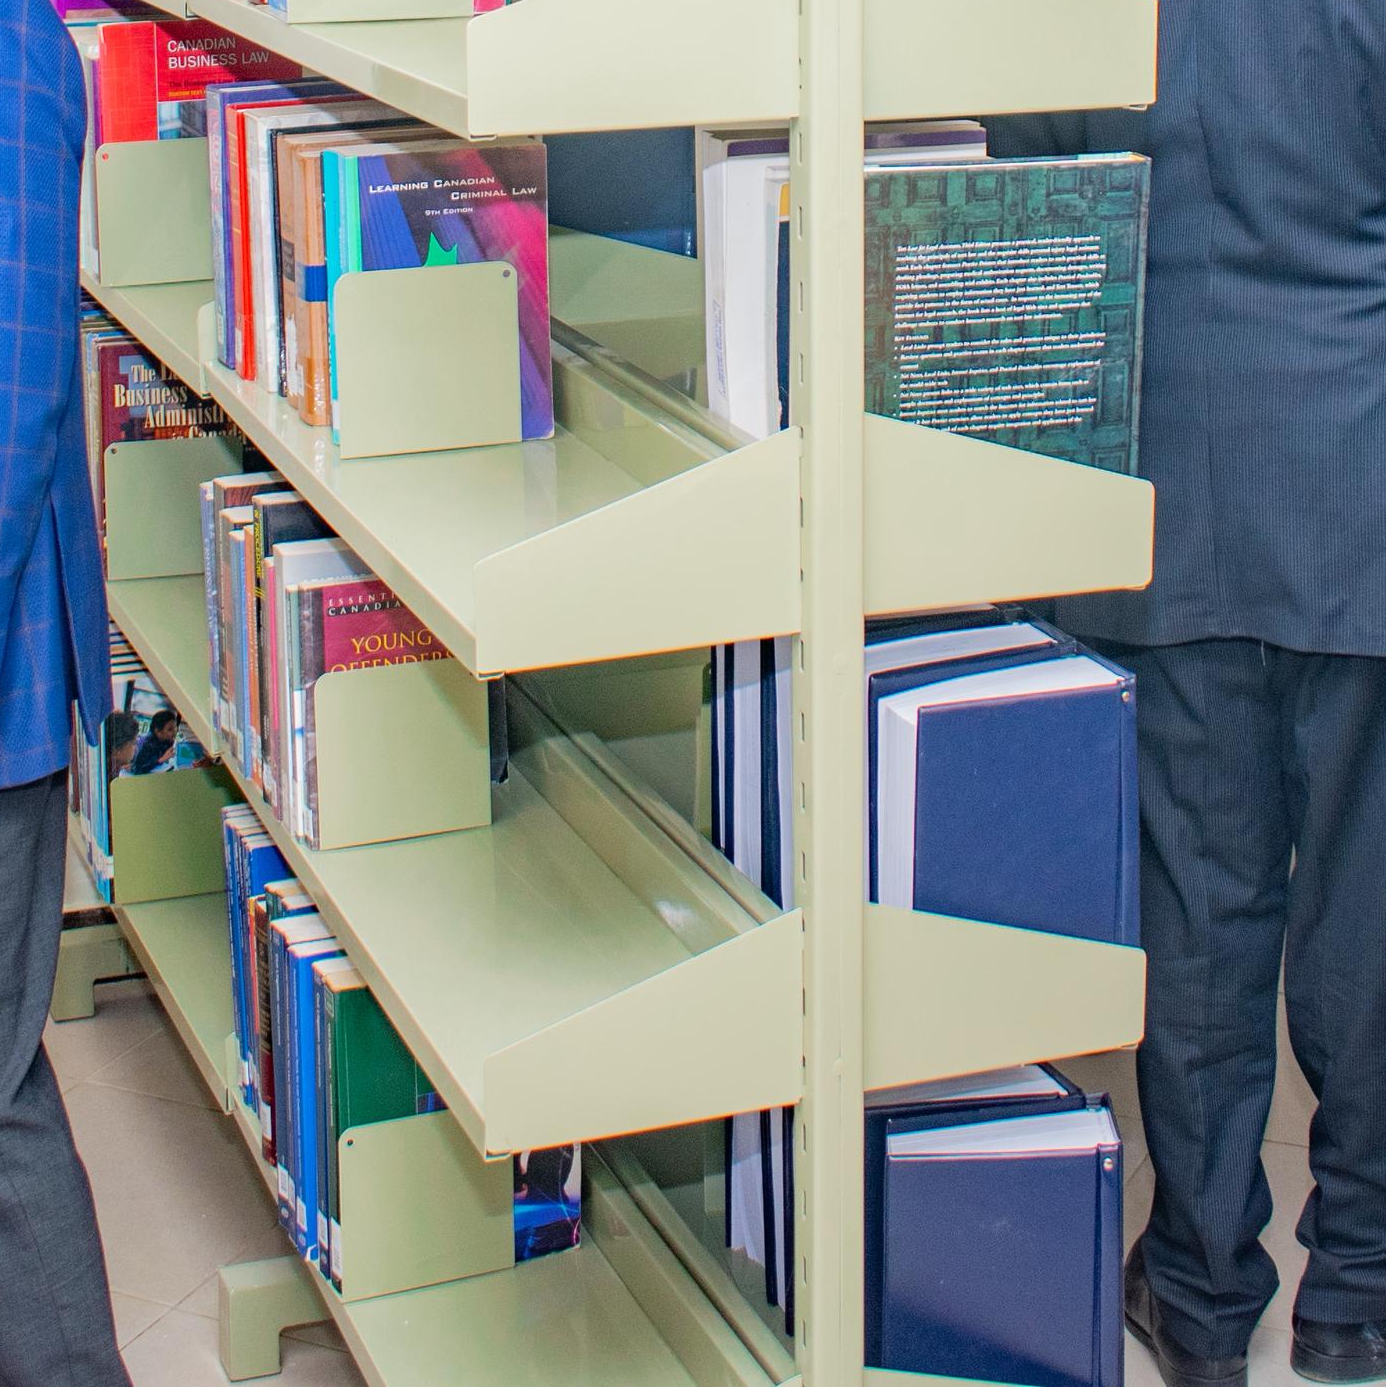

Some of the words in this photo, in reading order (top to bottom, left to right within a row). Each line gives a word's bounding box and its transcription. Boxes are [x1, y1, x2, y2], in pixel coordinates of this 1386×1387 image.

[167, 37, 236, 53] CANADIAN
[168, 53, 237, 69] BUSINESS
[242, 51, 270, 65] LAW
[130, 364, 156, 383] The
[160, 364, 178, 382] La
[113, 383, 188, 408] Business
[328, 592, 395, 607] ESSENTI
[328, 600, 401, 616] CANADIA
[351, 628, 432, 655] YOUNG
